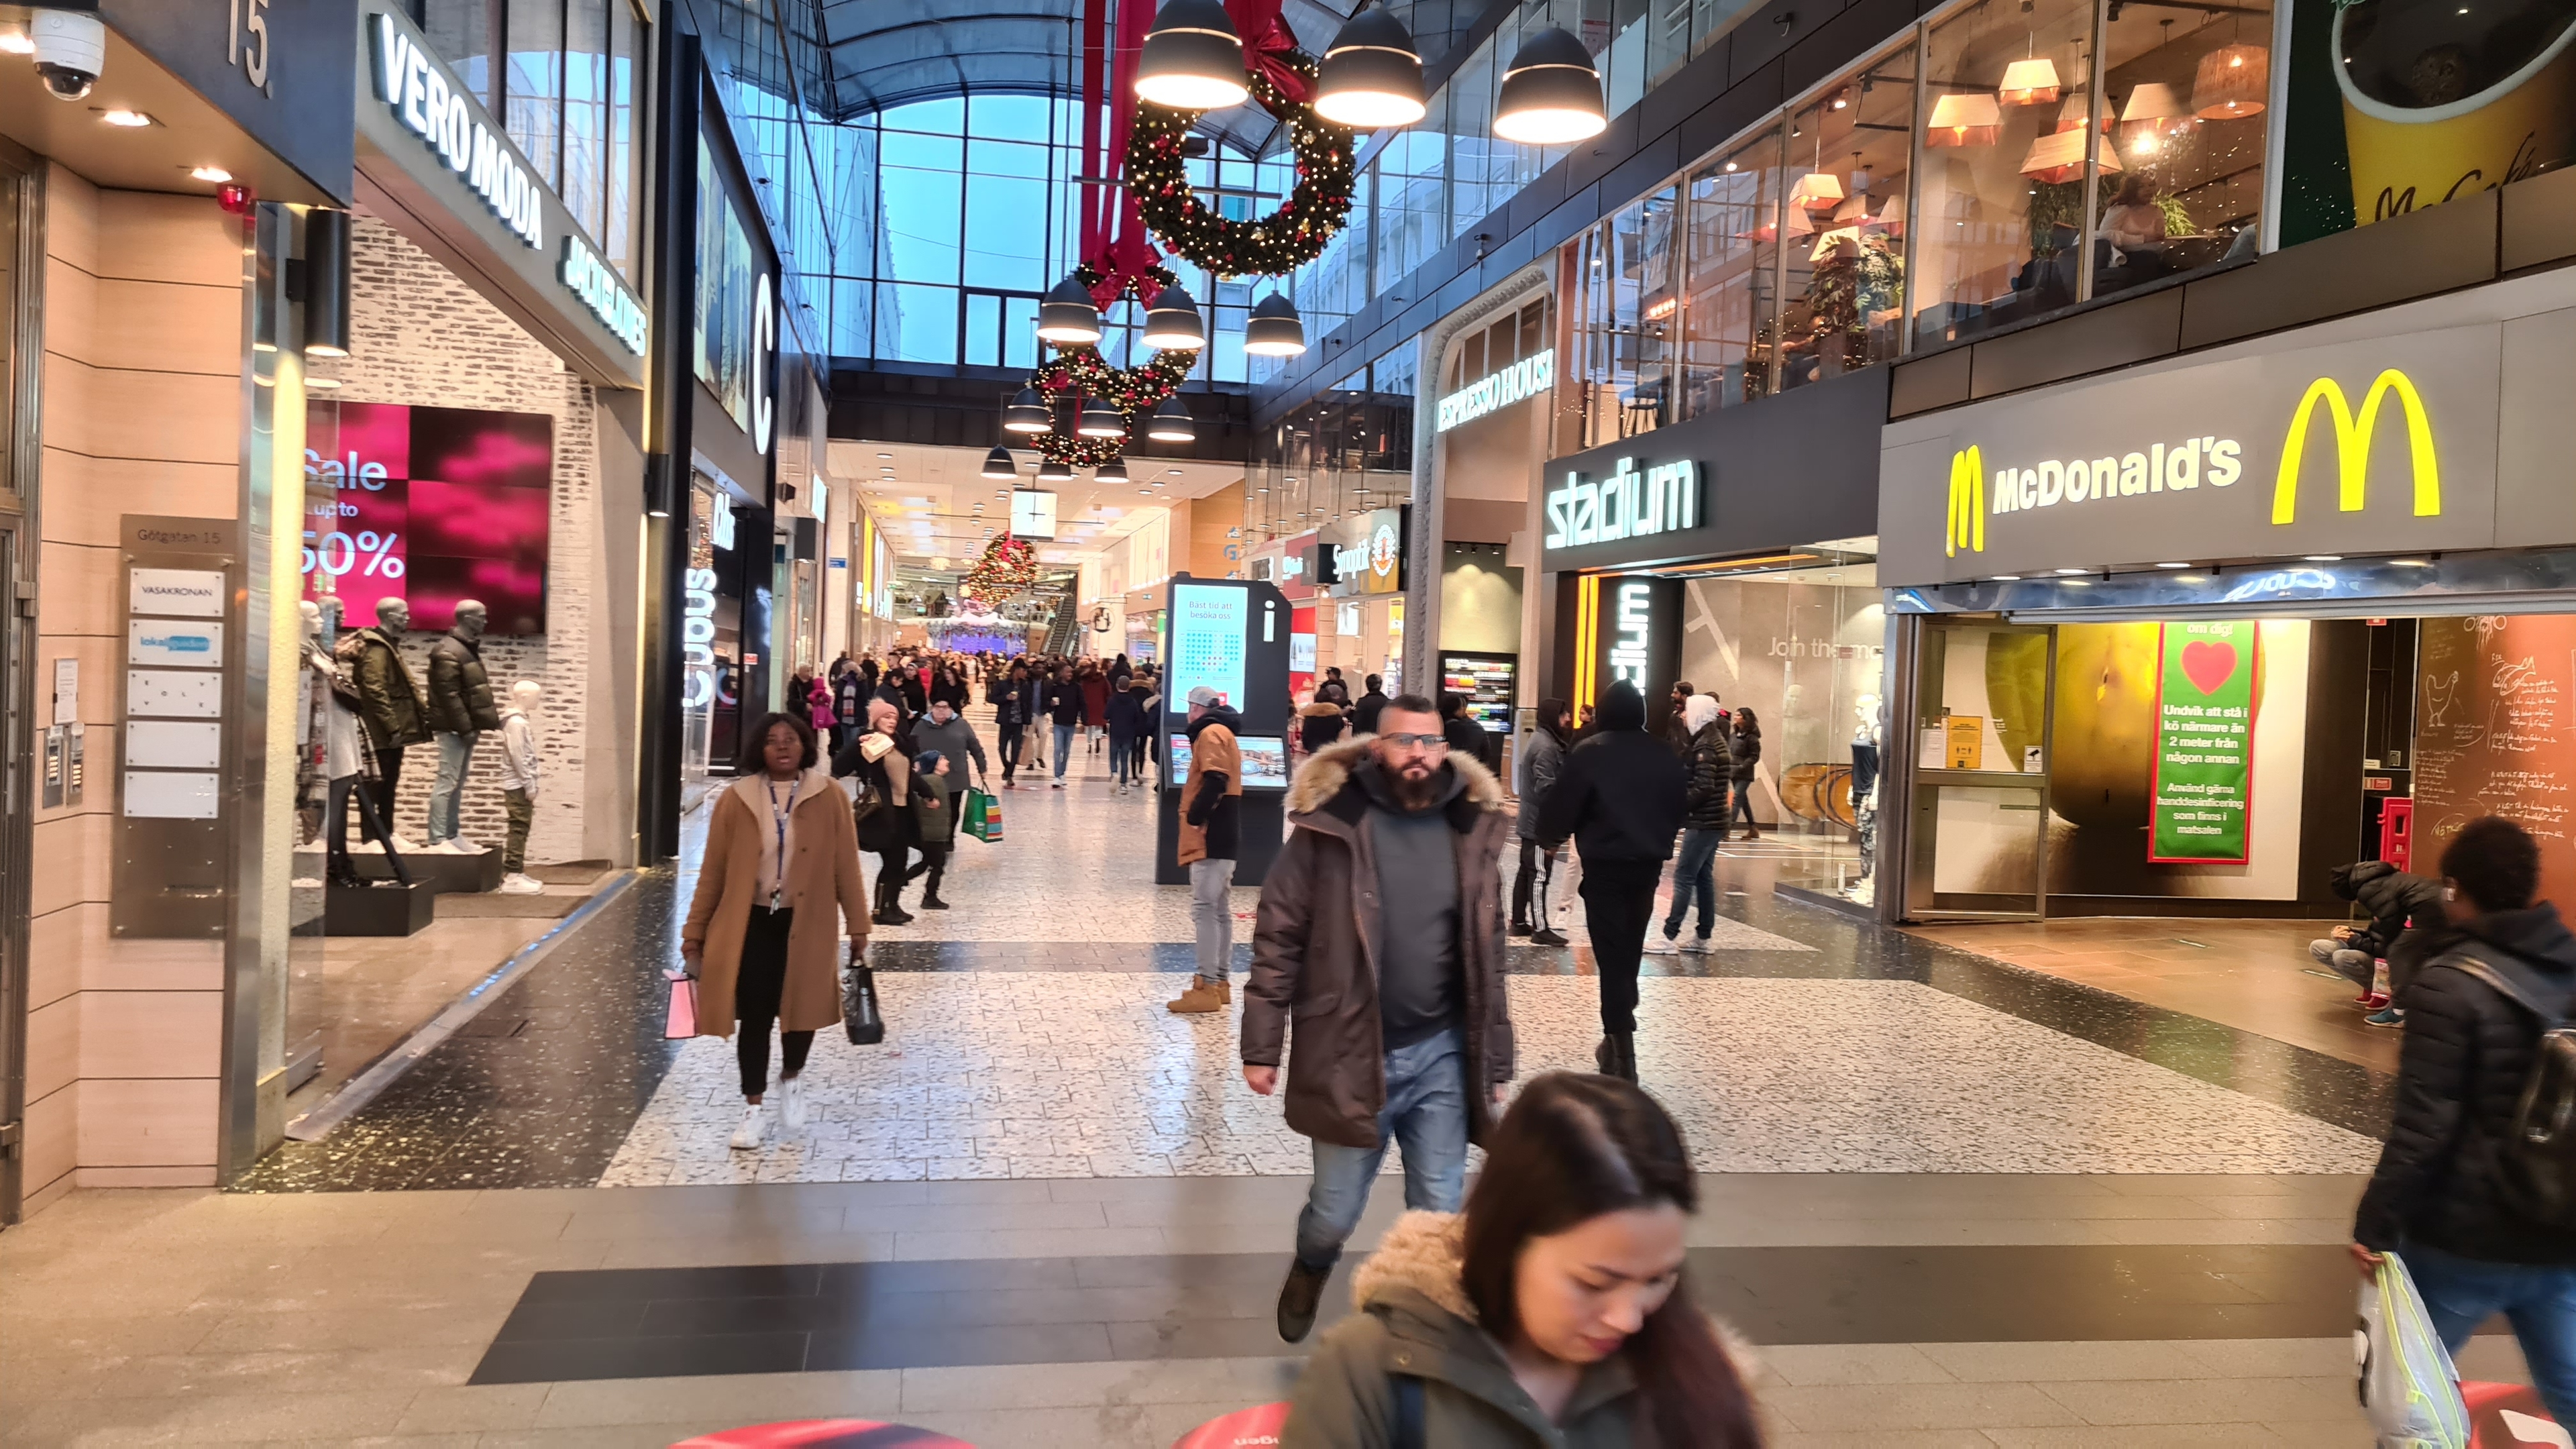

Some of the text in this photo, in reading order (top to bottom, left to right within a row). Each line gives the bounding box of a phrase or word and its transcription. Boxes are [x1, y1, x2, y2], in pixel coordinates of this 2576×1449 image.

[381, 13, 543, 250] VERO MODA
[1437, 373, 1501, 433] ESPRESSO
[304, 447, 388, 491] Sale
[1992, 436, 2243, 515] McDonald's
[314, 502, 359, 520] up to
[1545, 456, 1694, 550] stadium
[138, 528, 221, 545] Götgatan 15
[301, 530, 406, 578] 50%
[1333, 538, 1371, 582] Synoptik
[142, 586, 213, 596] VASAKRONAN
[1189, 600, 1207, 609] Bäst
[1190, 610, 1217, 619] besöka
[2210, 622, 2235, 637] dig!
[682, 568, 718, 708] cubus
[1768, 637, 1806, 657] Join
[2163, 704, 2248, 718] Undvik att stå i
[2163, 720, 2245, 733] kö närmare än
[2168, 736, 2239, 749] 2 meter från
[2165, 751, 2240, 765] någon annan
[2167, 782, 2235, 795] Använd gärna
[2173, 811, 2227, 821] som finns i
[2177, 825, 2222, 835] matsalen
